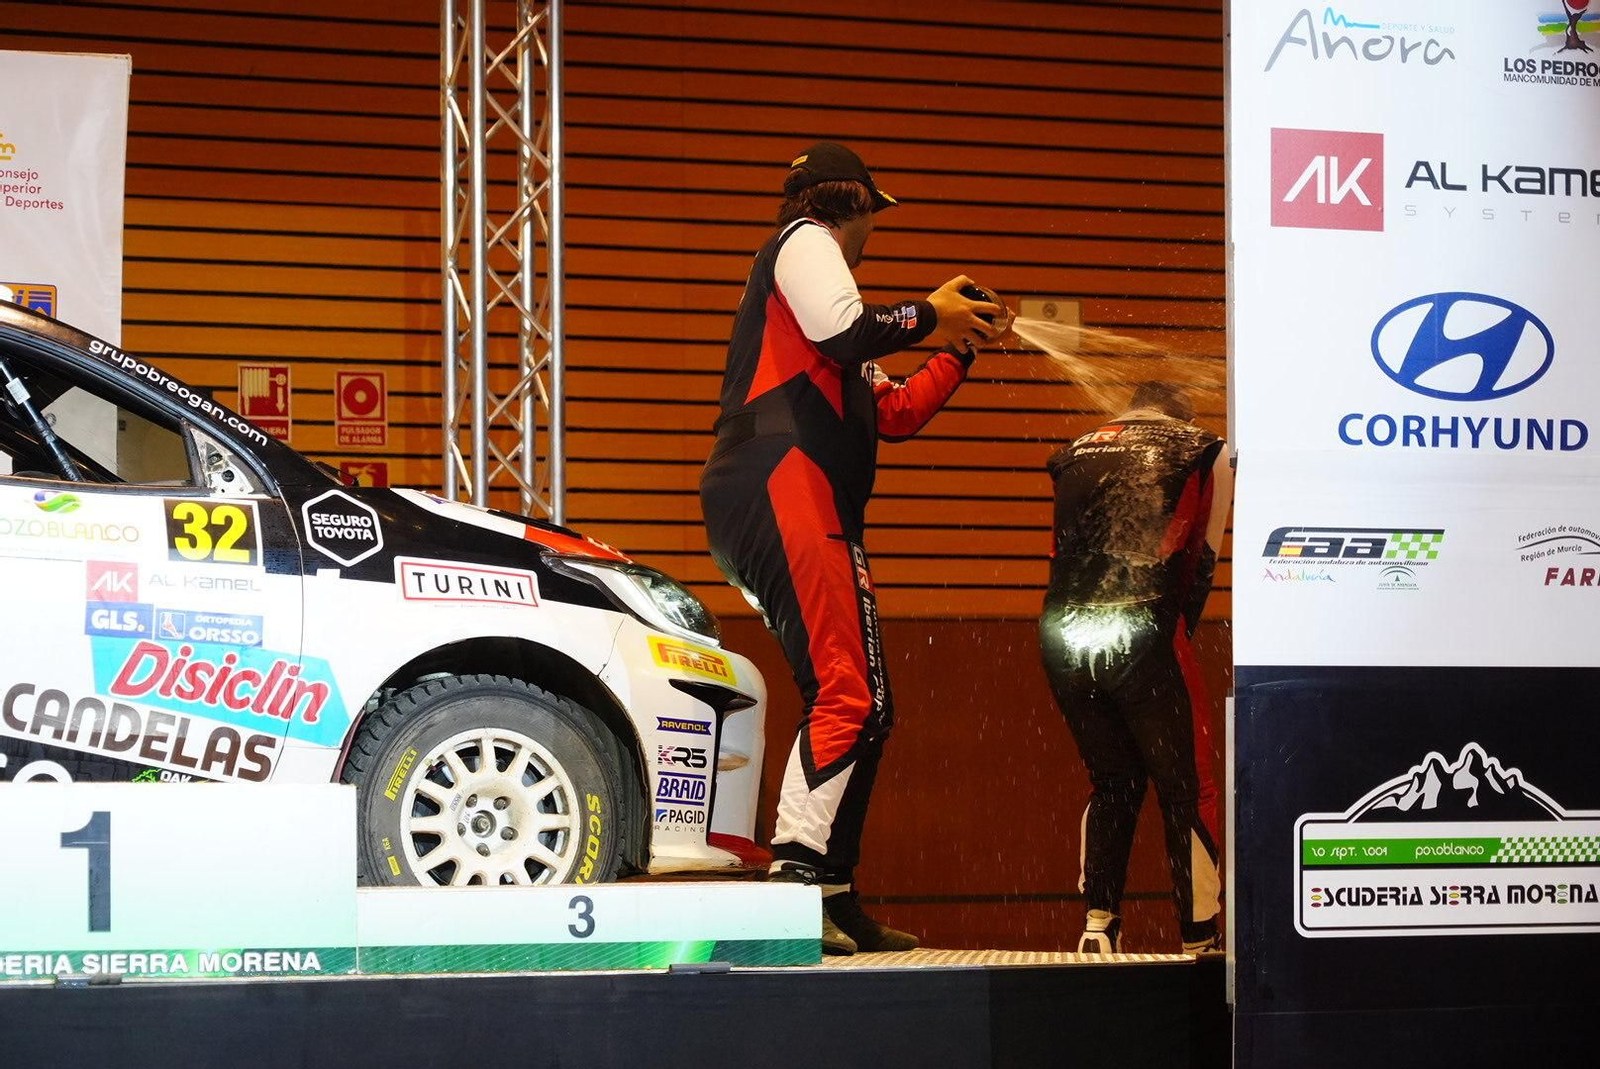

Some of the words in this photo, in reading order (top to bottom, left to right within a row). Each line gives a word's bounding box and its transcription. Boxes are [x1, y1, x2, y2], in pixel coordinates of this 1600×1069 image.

[1503, 57, 1537, 74] LOS
[1541, 59, 1600, 77] PEDRO
[1503, 73, 1578, 86] MANCOMUNIDAD
[1580, 77, 1592, 87] DE
[1405, 160, 1468, 192] AL
[5, 196, 64, 210] Deportes
[88, 339, 268, 447] grupobreogan.com
[1338, 412, 1589, 451] CORHYUND
[312, 513, 372, 528] SEGURO
[173, 502, 250, 563] 32
[314, 526, 375, 541] TOYOTA
[1518, 526, 1557, 543] Federación
[1558, 525, 1567, 533] de
[1568, 526, 1600, 541] automov
[1520, 551, 1546, 562] Región
[1547, 548, 1555, 556] de
[1557, 545, 1582, 554] Murcia
[149, 574, 176, 587] AL
[412, 571, 526, 600] TURINI
[1544, 567, 1600, 586] FAR
[91, 609, 145, 633] GLS.
[195, 615, 254, 626] ORTOPEDIA
[862, 596, 876, 668] Iberian
[188, 626, 260, 645] ORSSO
[657, 643, 729, 678] PIRELLI
[110, 641, 329, 723] Disiclin
[2, 683, 277, 782] CANDELAS
[661, 721, 706, 732] RAVENOL
[384, 747, 418, 802] PIRELLI
[656, 777, 706, 800] BRAID
[669, 809, 705, 824] PAGID
[60, 811, 111, 932] 1
[567, 895, 596, 939] 3
[81, 953, 190, 975] SIERRA
[198, 951, 322, 973] MORENA
